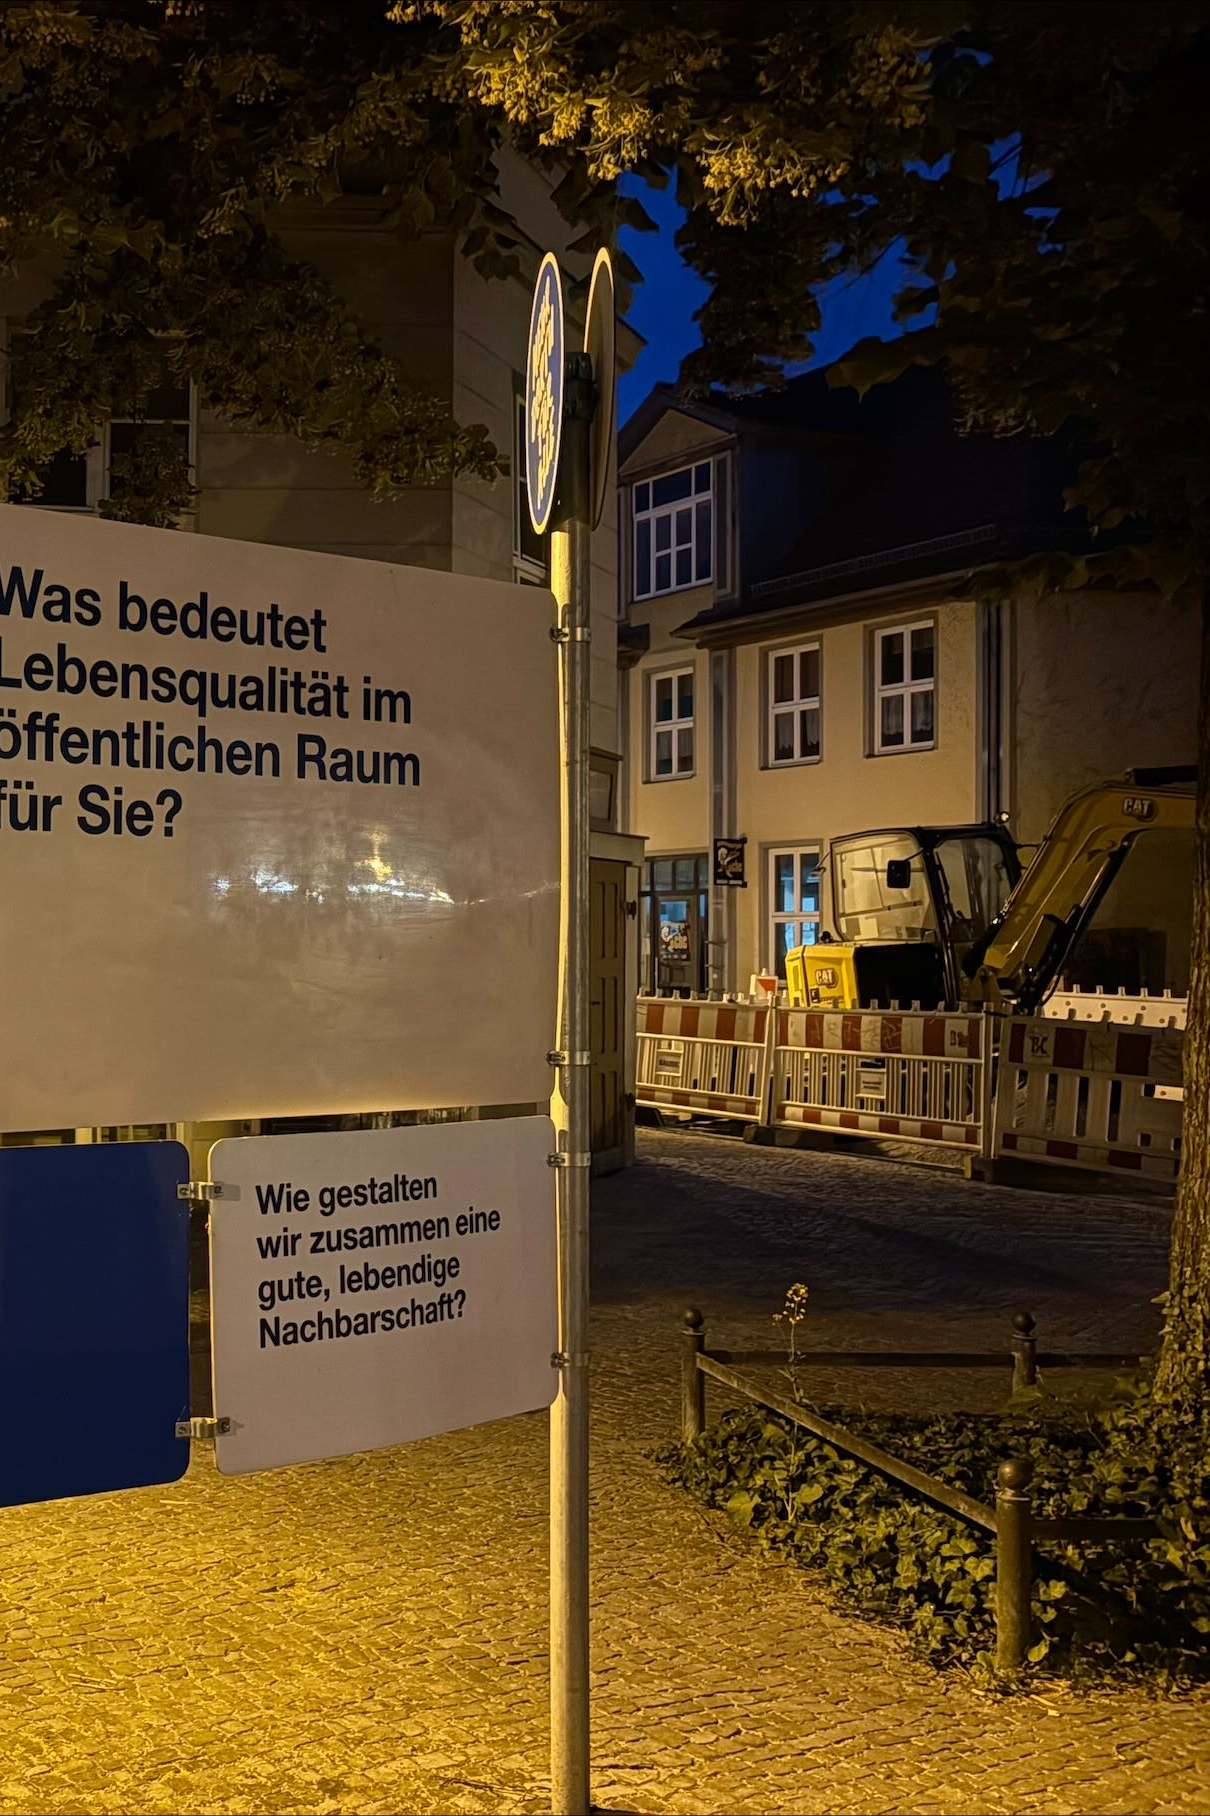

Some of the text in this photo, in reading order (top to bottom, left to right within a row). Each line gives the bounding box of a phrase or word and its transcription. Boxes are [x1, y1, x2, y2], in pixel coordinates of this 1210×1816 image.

[119, 581, 326, 653] bedeutet
[364, 676, 410, 724] im
[298, 734, 419, 786] Raum
[77, 784, 182, 837] Sie?
[1123, 798, 1151, 817] CAT
[815, 968, 834, 986] CAT
[255, 1174, 437, 1216] Wie gestalten
[257, 1205, 500, 1258] wir zusammen eine
[257, 1254, 459, 1311] gute, lebendige
[260, 1289, 466, 1348] Nachbarschaft?
